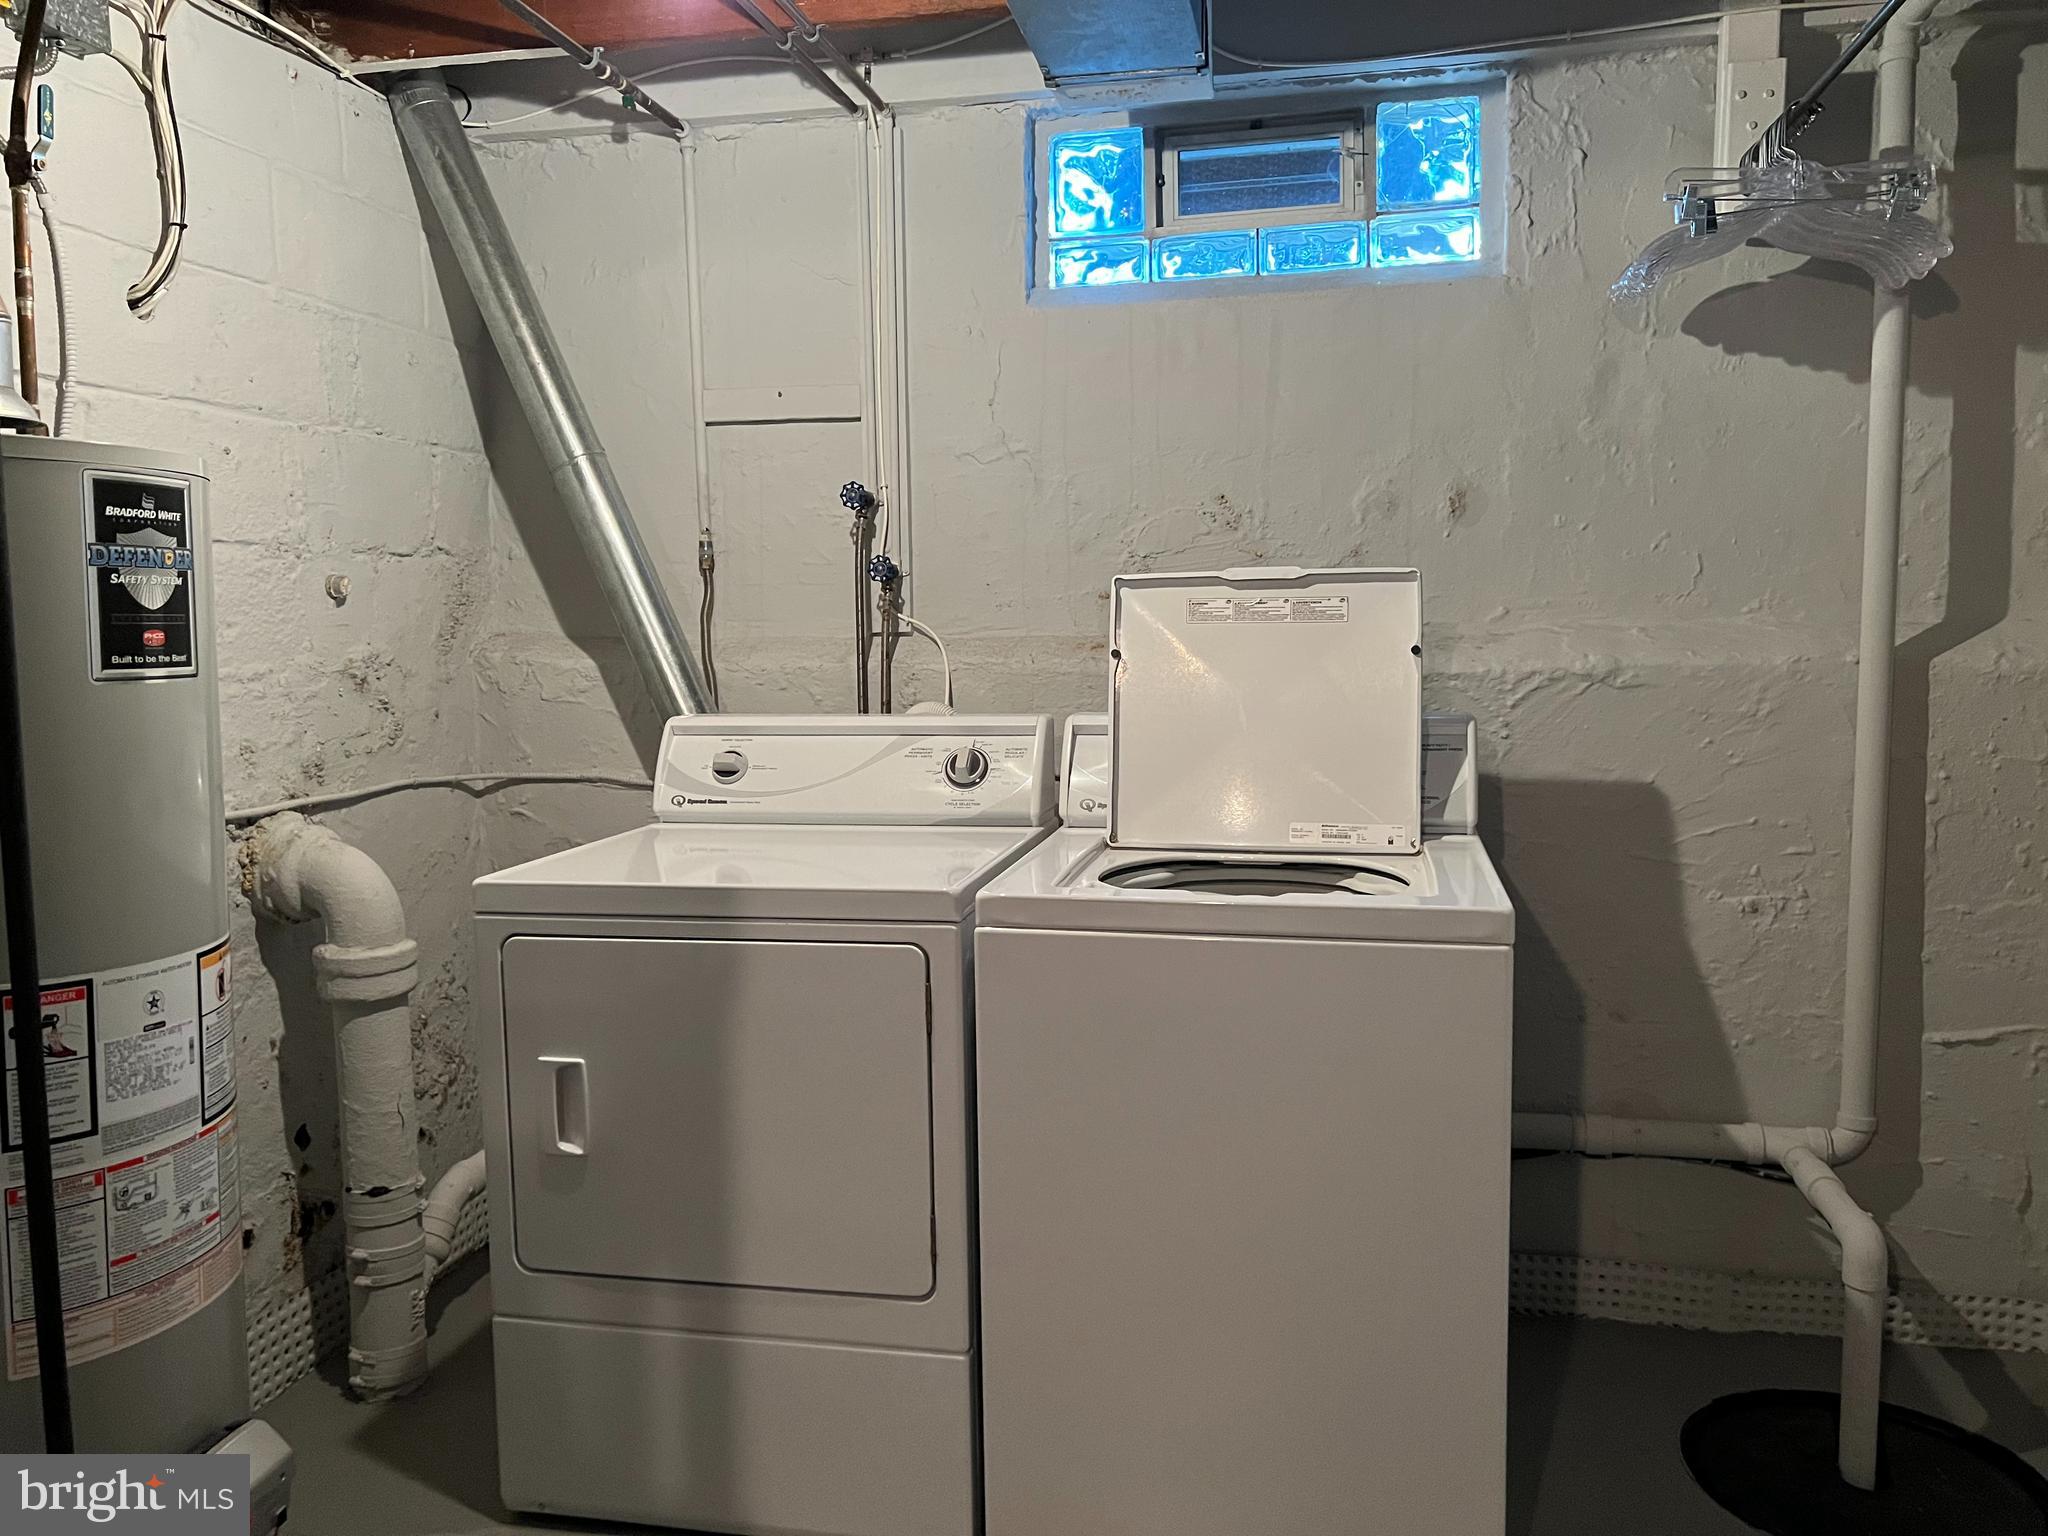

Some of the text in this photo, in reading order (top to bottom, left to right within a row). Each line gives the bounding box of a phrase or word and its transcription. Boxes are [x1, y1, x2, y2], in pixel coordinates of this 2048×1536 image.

[105, 505, 182, 521] BRADFORD WHITE
[88, 543, 193, 571] DEFENDER
[110, 573, 183, 586] SAFETY SYSTEM
[111, 654, 187, 664] Built to be the Best
[40, 991, 77, 1003] ANGER
